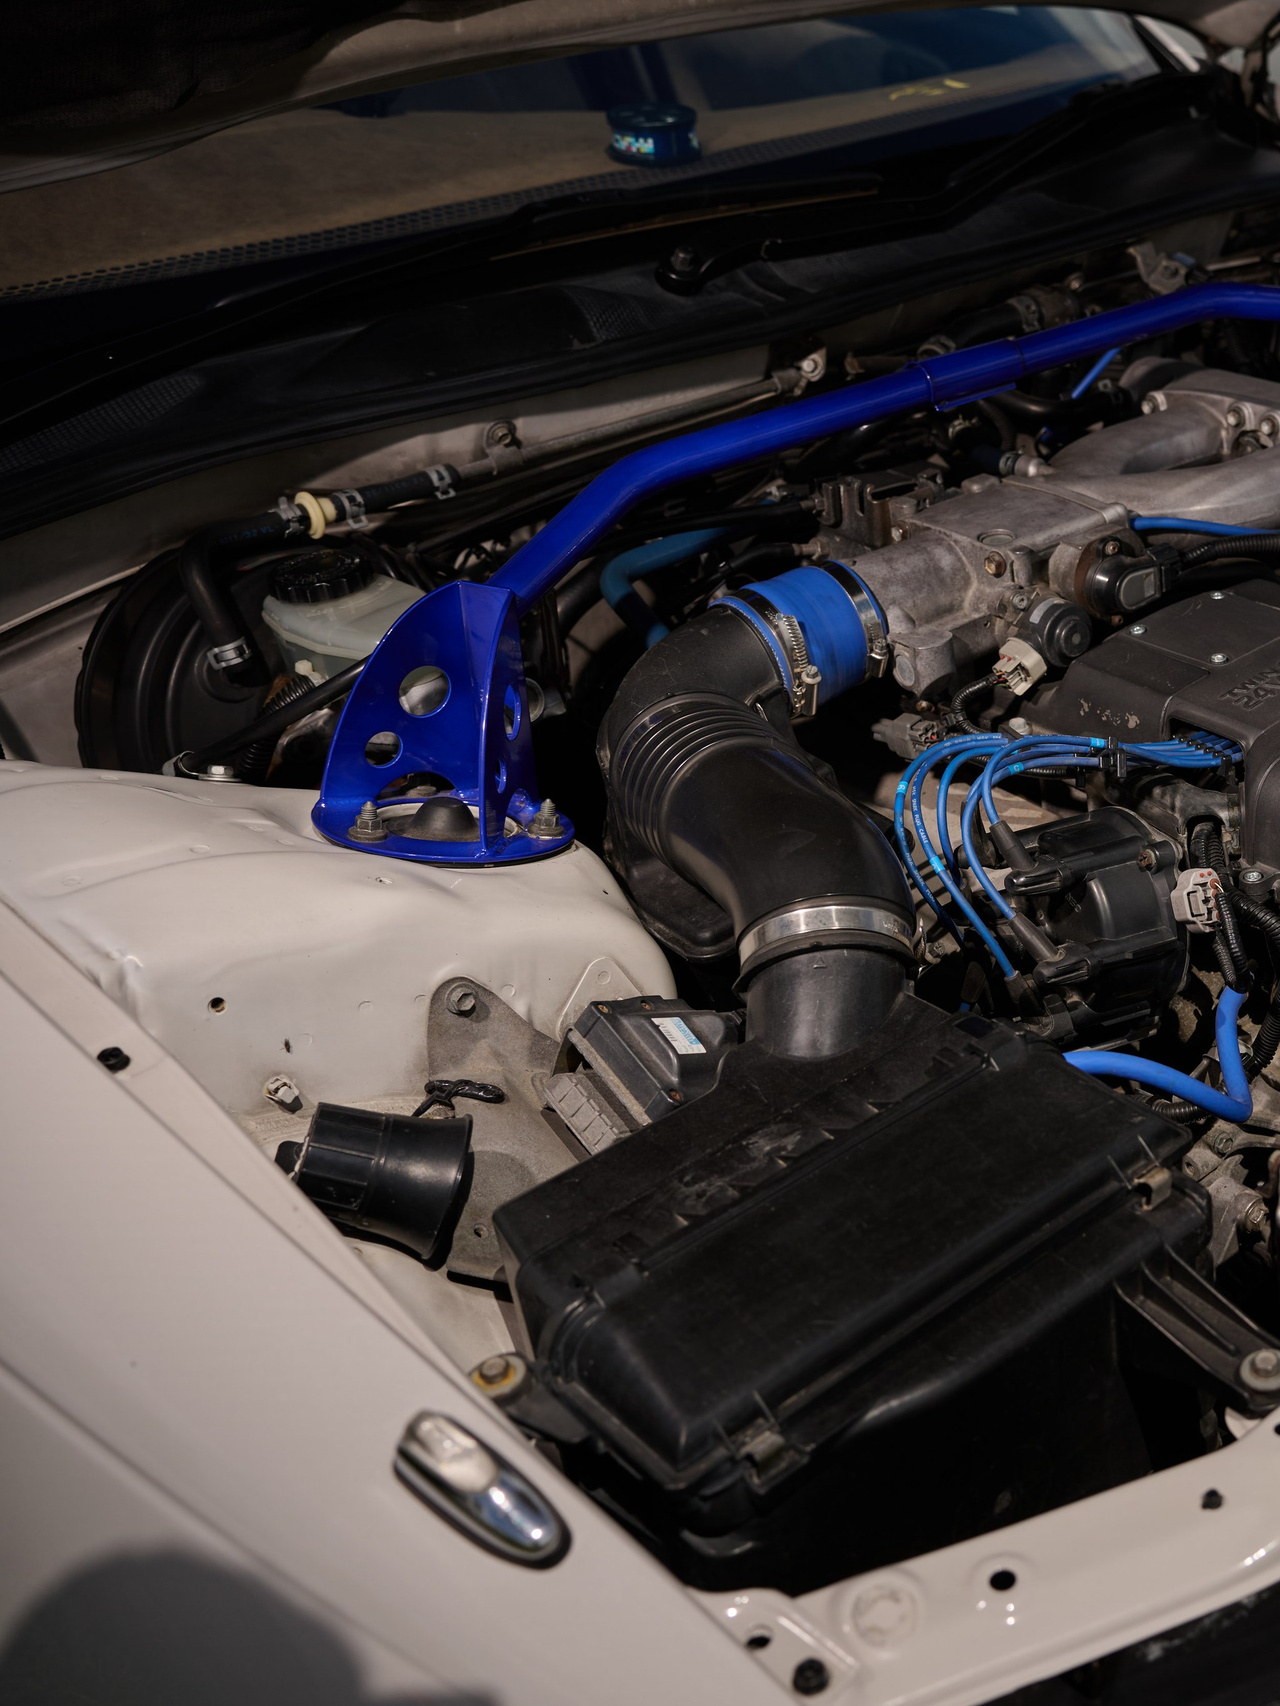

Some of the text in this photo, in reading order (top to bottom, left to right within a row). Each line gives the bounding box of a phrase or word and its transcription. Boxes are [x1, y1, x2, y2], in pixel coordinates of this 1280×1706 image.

[1218, 668, 1280, 699] TWIN
[919, 828, 929, 844] CABLE
[913, 869, 926, 887] SPARK
